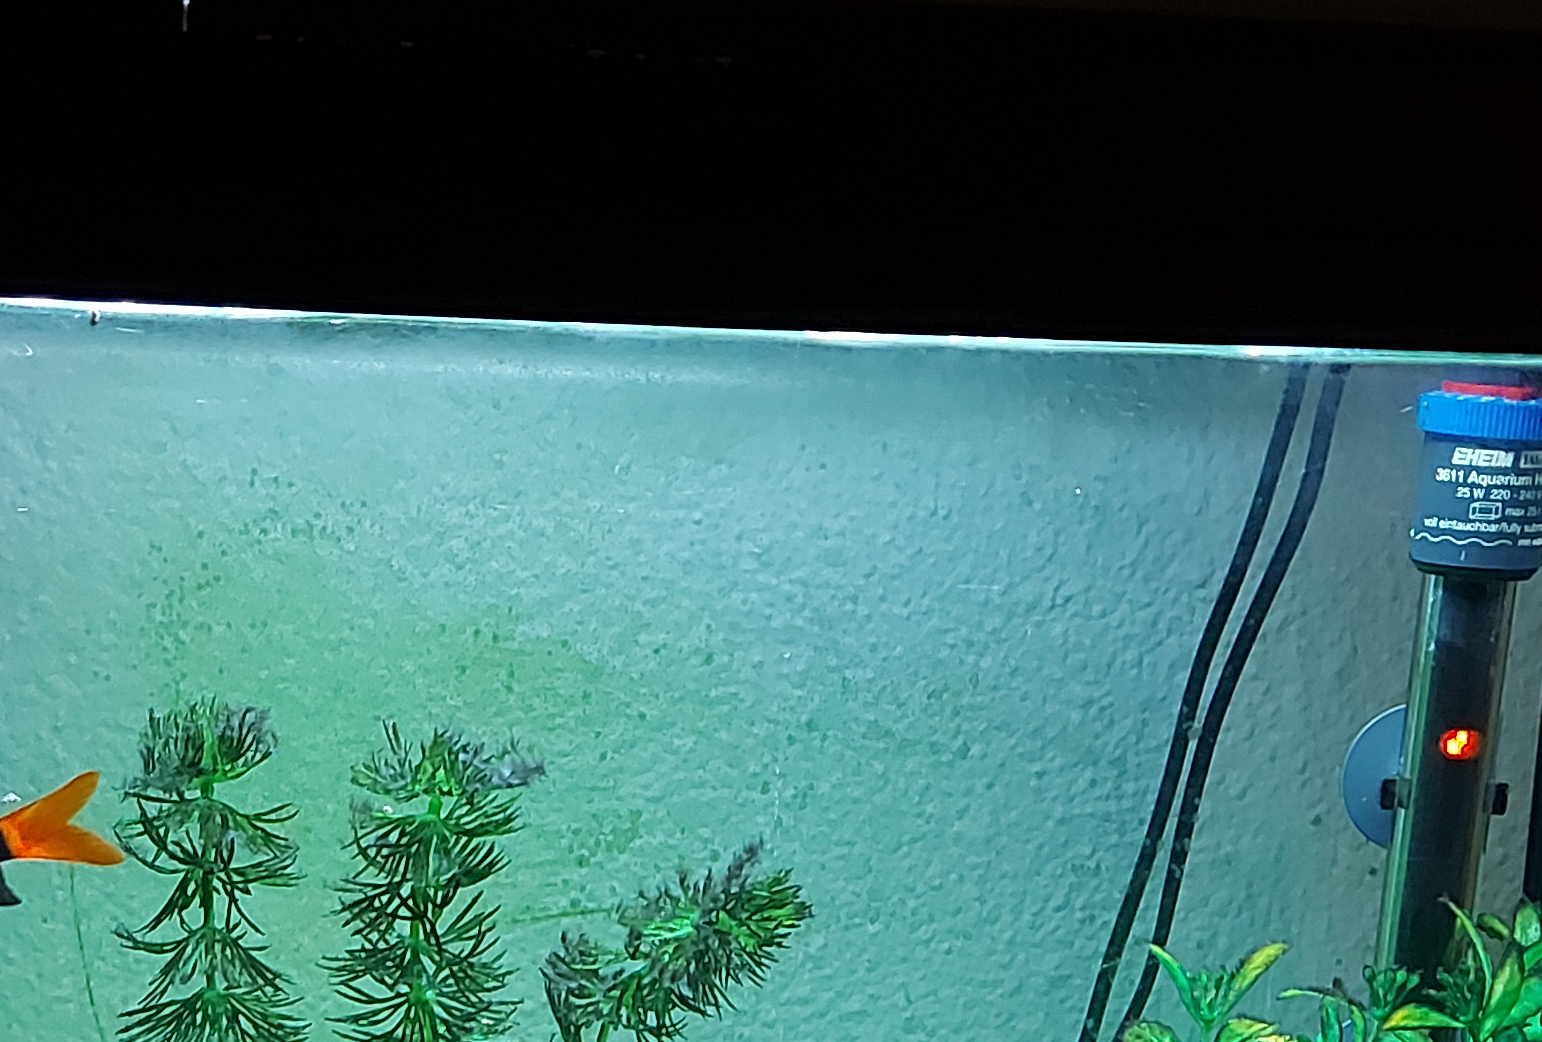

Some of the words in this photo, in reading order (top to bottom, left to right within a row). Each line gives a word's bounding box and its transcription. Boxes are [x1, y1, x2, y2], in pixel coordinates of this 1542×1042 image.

[1452, 447, 1515, 467] EHEIM
[1467, 470, 1532, 487] Aquarium
[1455, 487, 1471, 498] 25
[1473, 488, 1486, 499] W
[1490, 489, 1510, 500] 220
